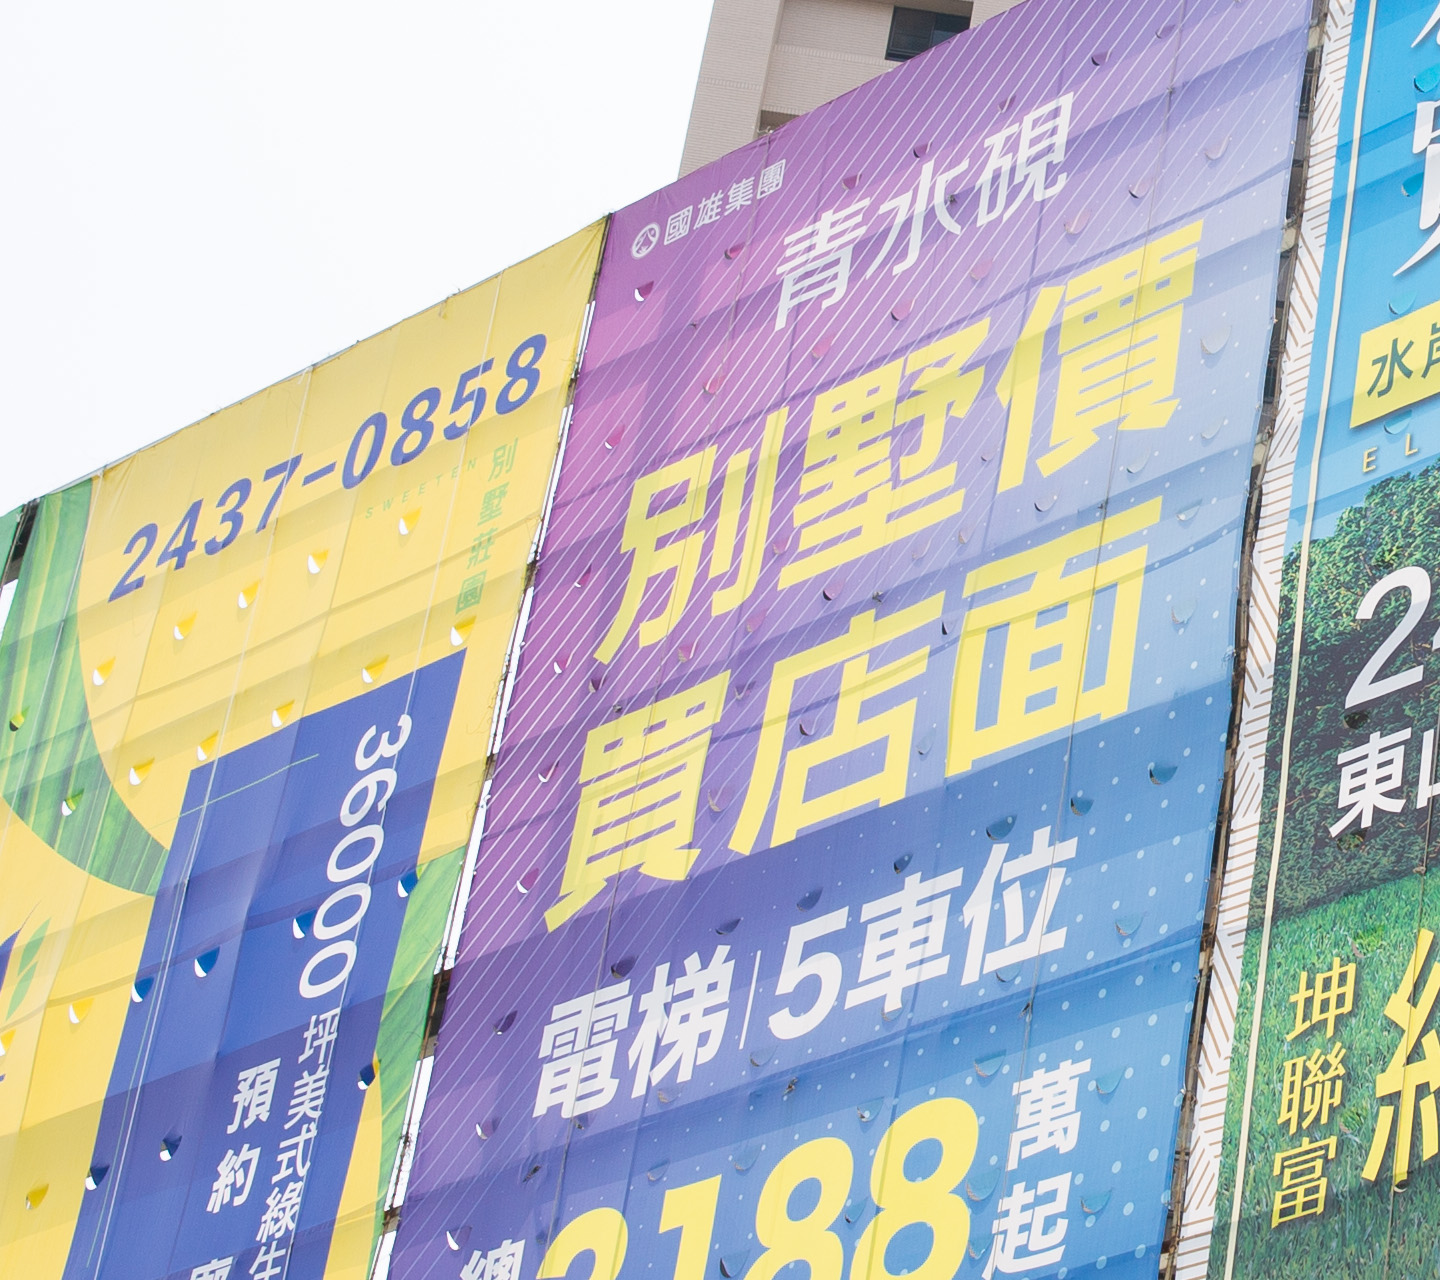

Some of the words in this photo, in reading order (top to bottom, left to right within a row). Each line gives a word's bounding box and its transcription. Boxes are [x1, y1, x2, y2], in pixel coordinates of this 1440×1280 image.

[663, 158, 787, 246] 國雄集團
[774, 91, 1075, 332] 青水硯
[107, 333, 548, 604] 2437-0858
[365, 457, 479, 519] SWEETEN
[454, 437, 519, 615] 別墅莊園
[593, 218, 1206, 666] 別墅價
[544, 494, 1164, 933] 買店面
[532, 945, 736, 1120] 電梯
[769, 826, 1079, 1042] 5車位
[1271, 956, 1357, 1230] 坤聯富
[207, 1058, 282, 1215] 預約
